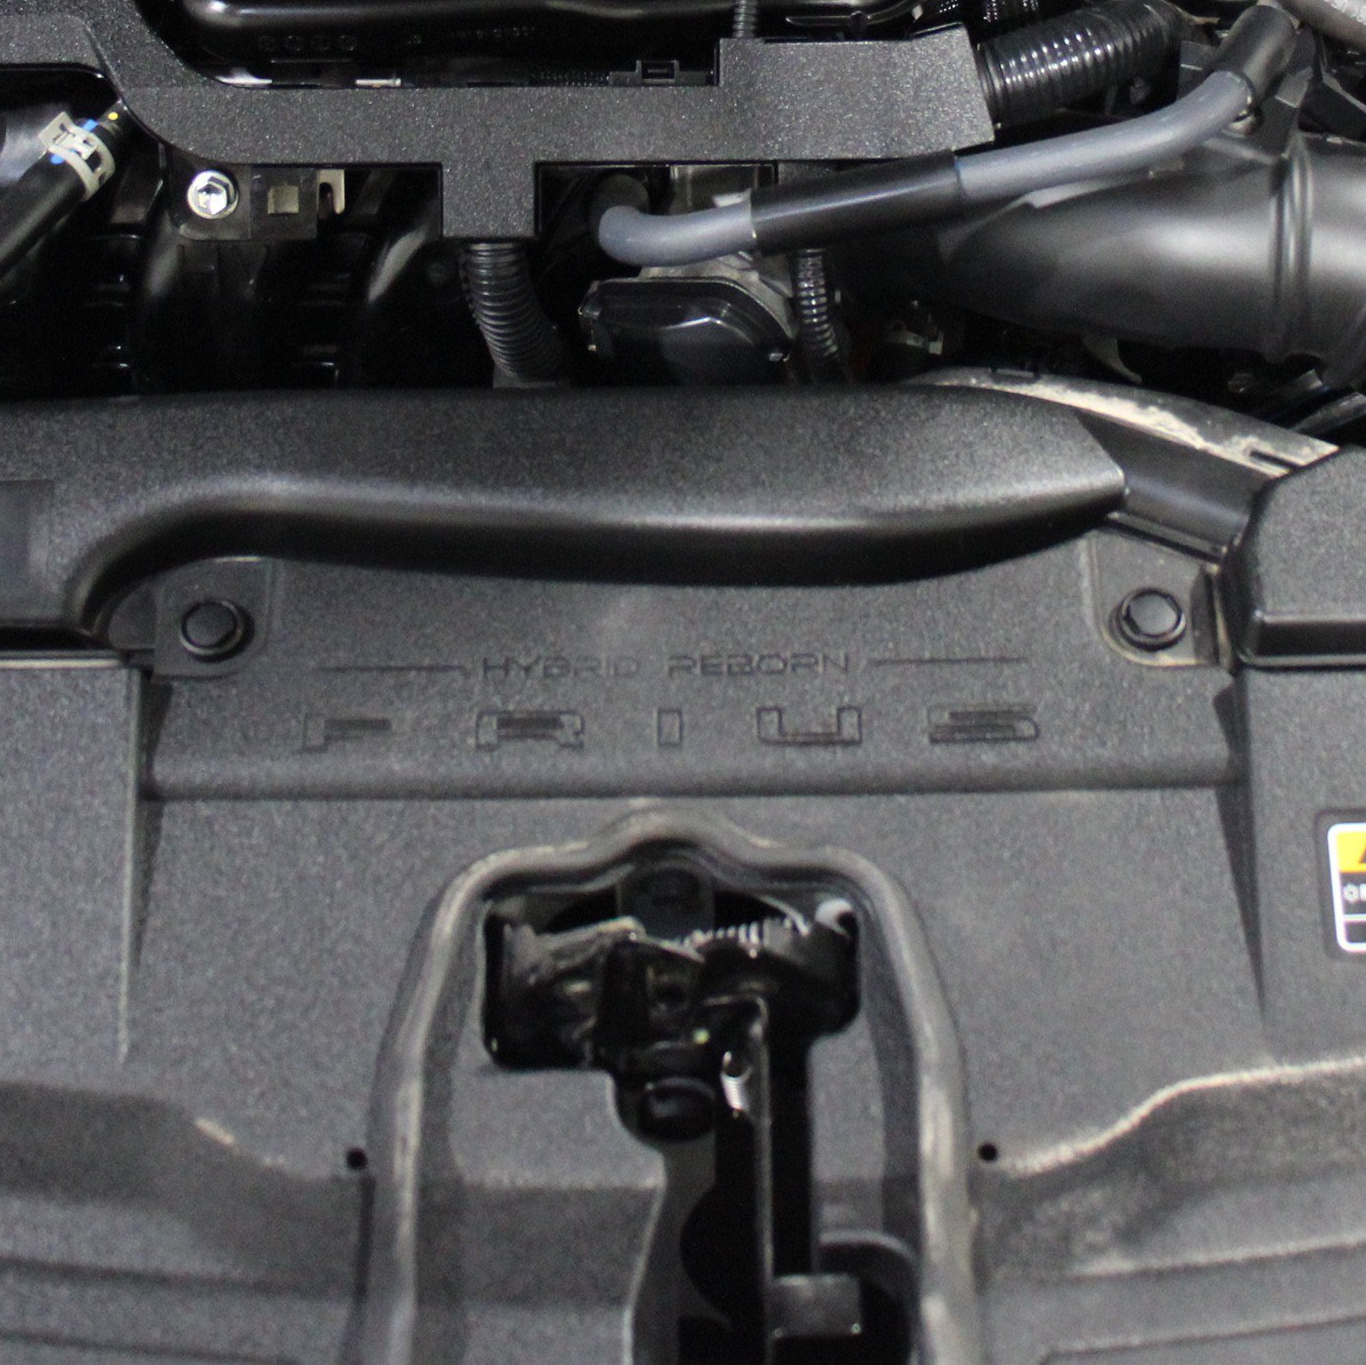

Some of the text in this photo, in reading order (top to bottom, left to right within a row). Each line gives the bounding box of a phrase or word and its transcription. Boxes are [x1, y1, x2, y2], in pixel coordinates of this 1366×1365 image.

[481, 653, 850, 679] HYBRID REBORN
[303, 704, 1040, 752] PRIUS
